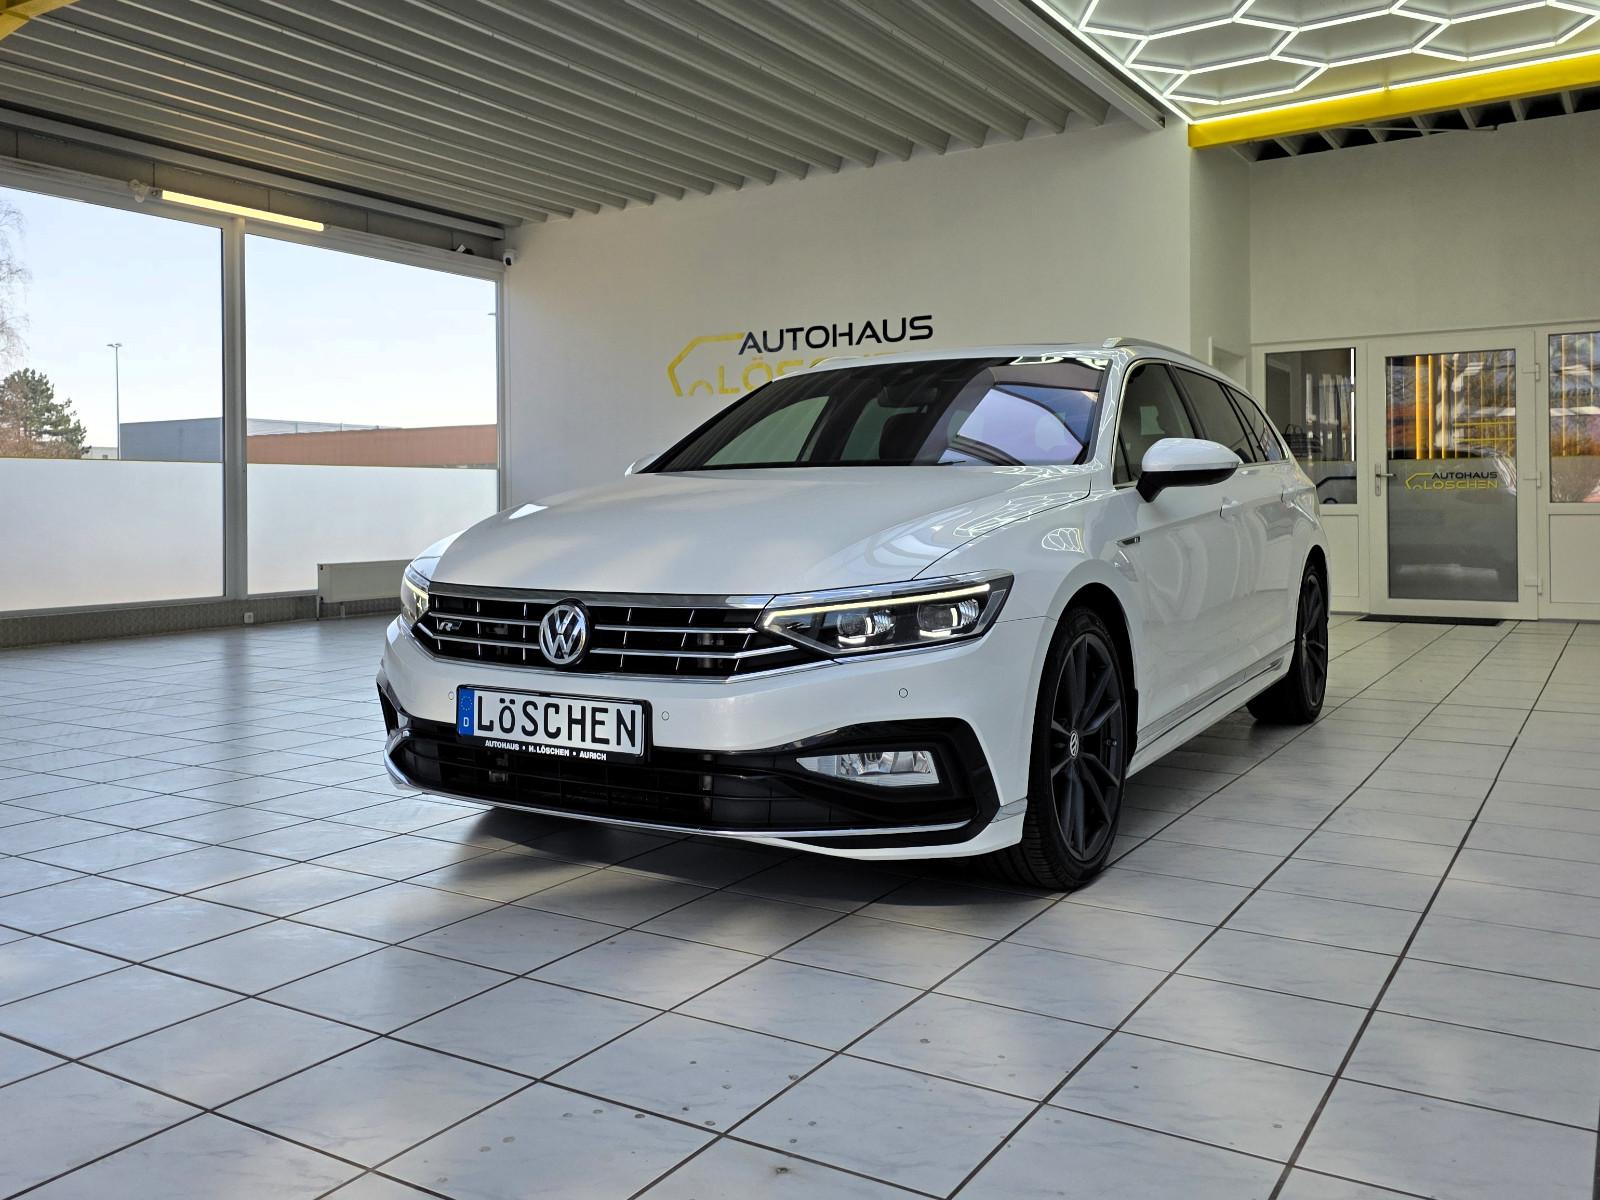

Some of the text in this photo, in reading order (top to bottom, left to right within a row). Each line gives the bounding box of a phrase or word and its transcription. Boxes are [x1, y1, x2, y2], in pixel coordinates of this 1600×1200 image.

[738, 315, 934, 355] AUTOHAUS
[1432, 471, 1498, 480] AUTOHAUS
[463, 716, 470, 727] D
[477, 696, 636, 748] LÖSCHEN
[485, 740, 520, 750] AUTOHAUS
[579, 750, 607, 761] AURICH
